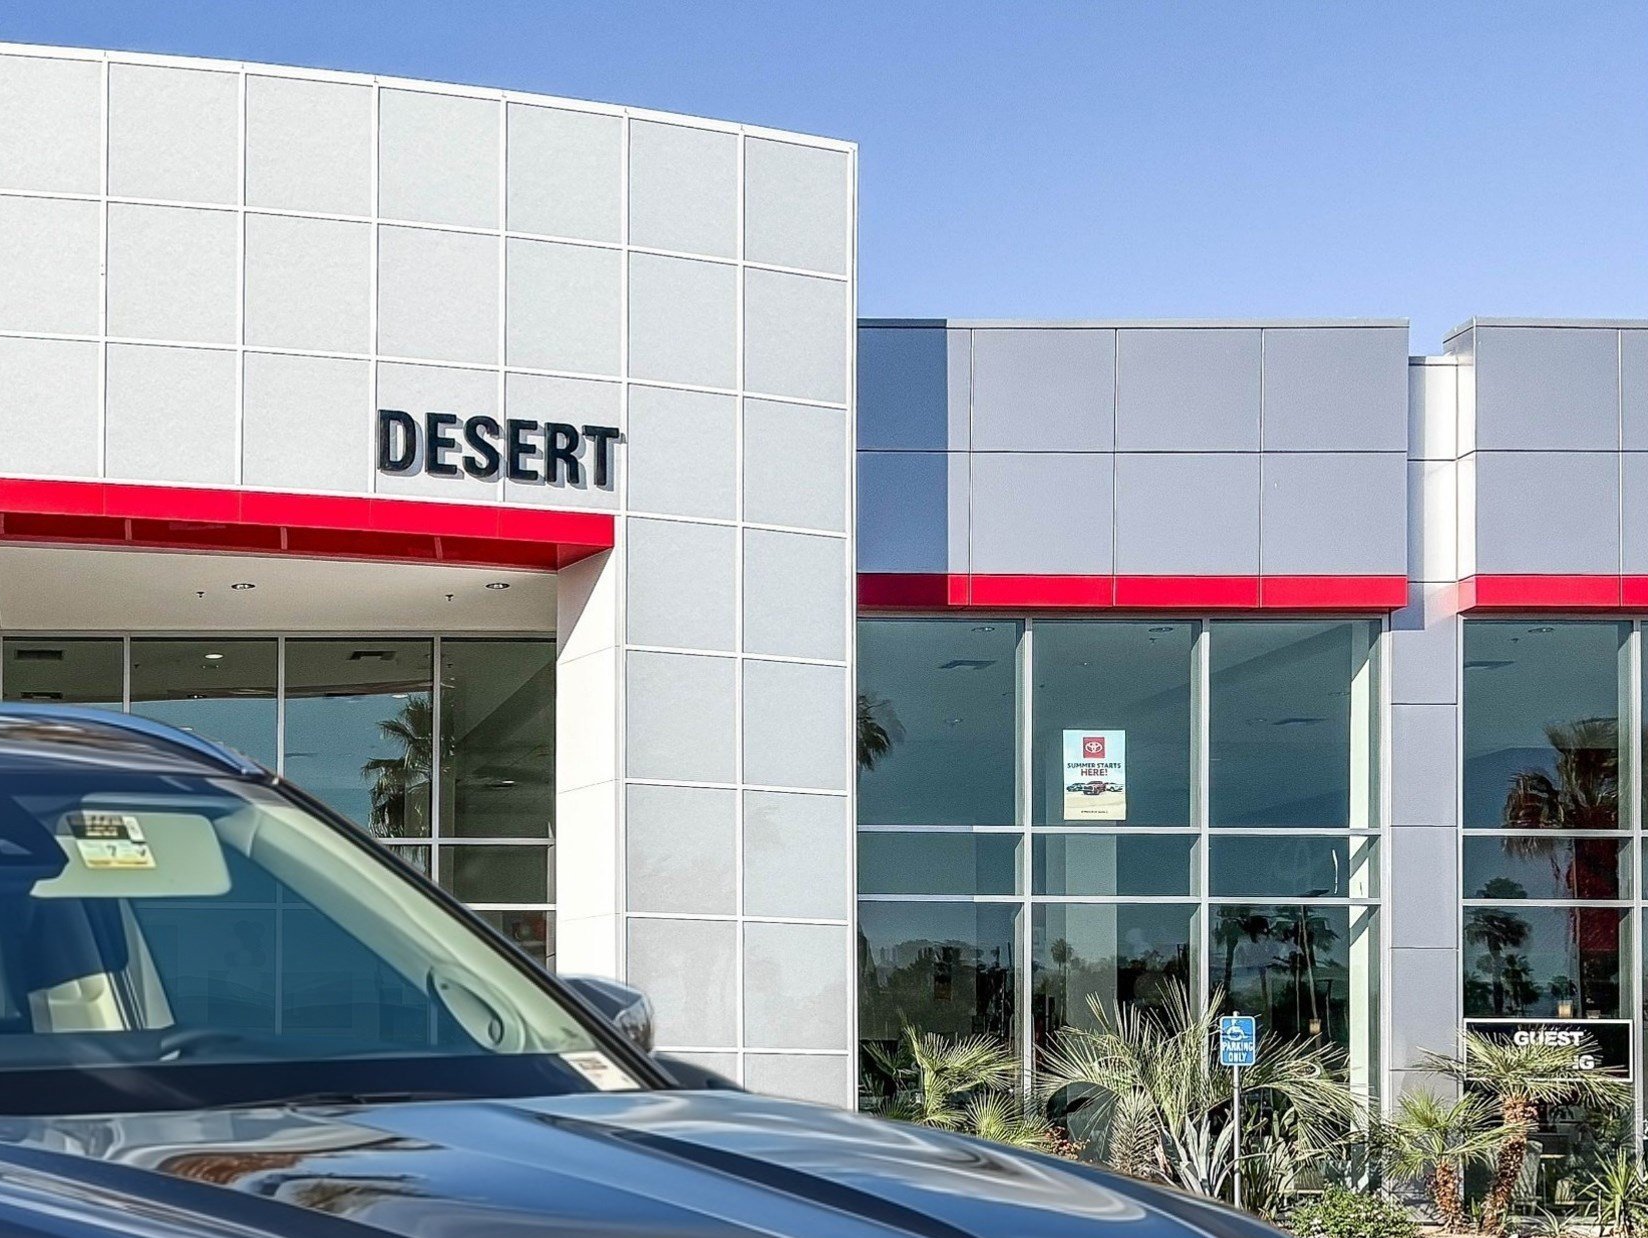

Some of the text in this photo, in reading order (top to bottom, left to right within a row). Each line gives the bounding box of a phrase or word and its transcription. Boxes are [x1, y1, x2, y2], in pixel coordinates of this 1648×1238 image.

[377, 409, 620, 486] DESERT
[1513, 1031, 1584, 1046] GUEST
[1222, 1041, 1253, 1051] PARKING
[1228, 1052, 1247, 1062] ONLY
